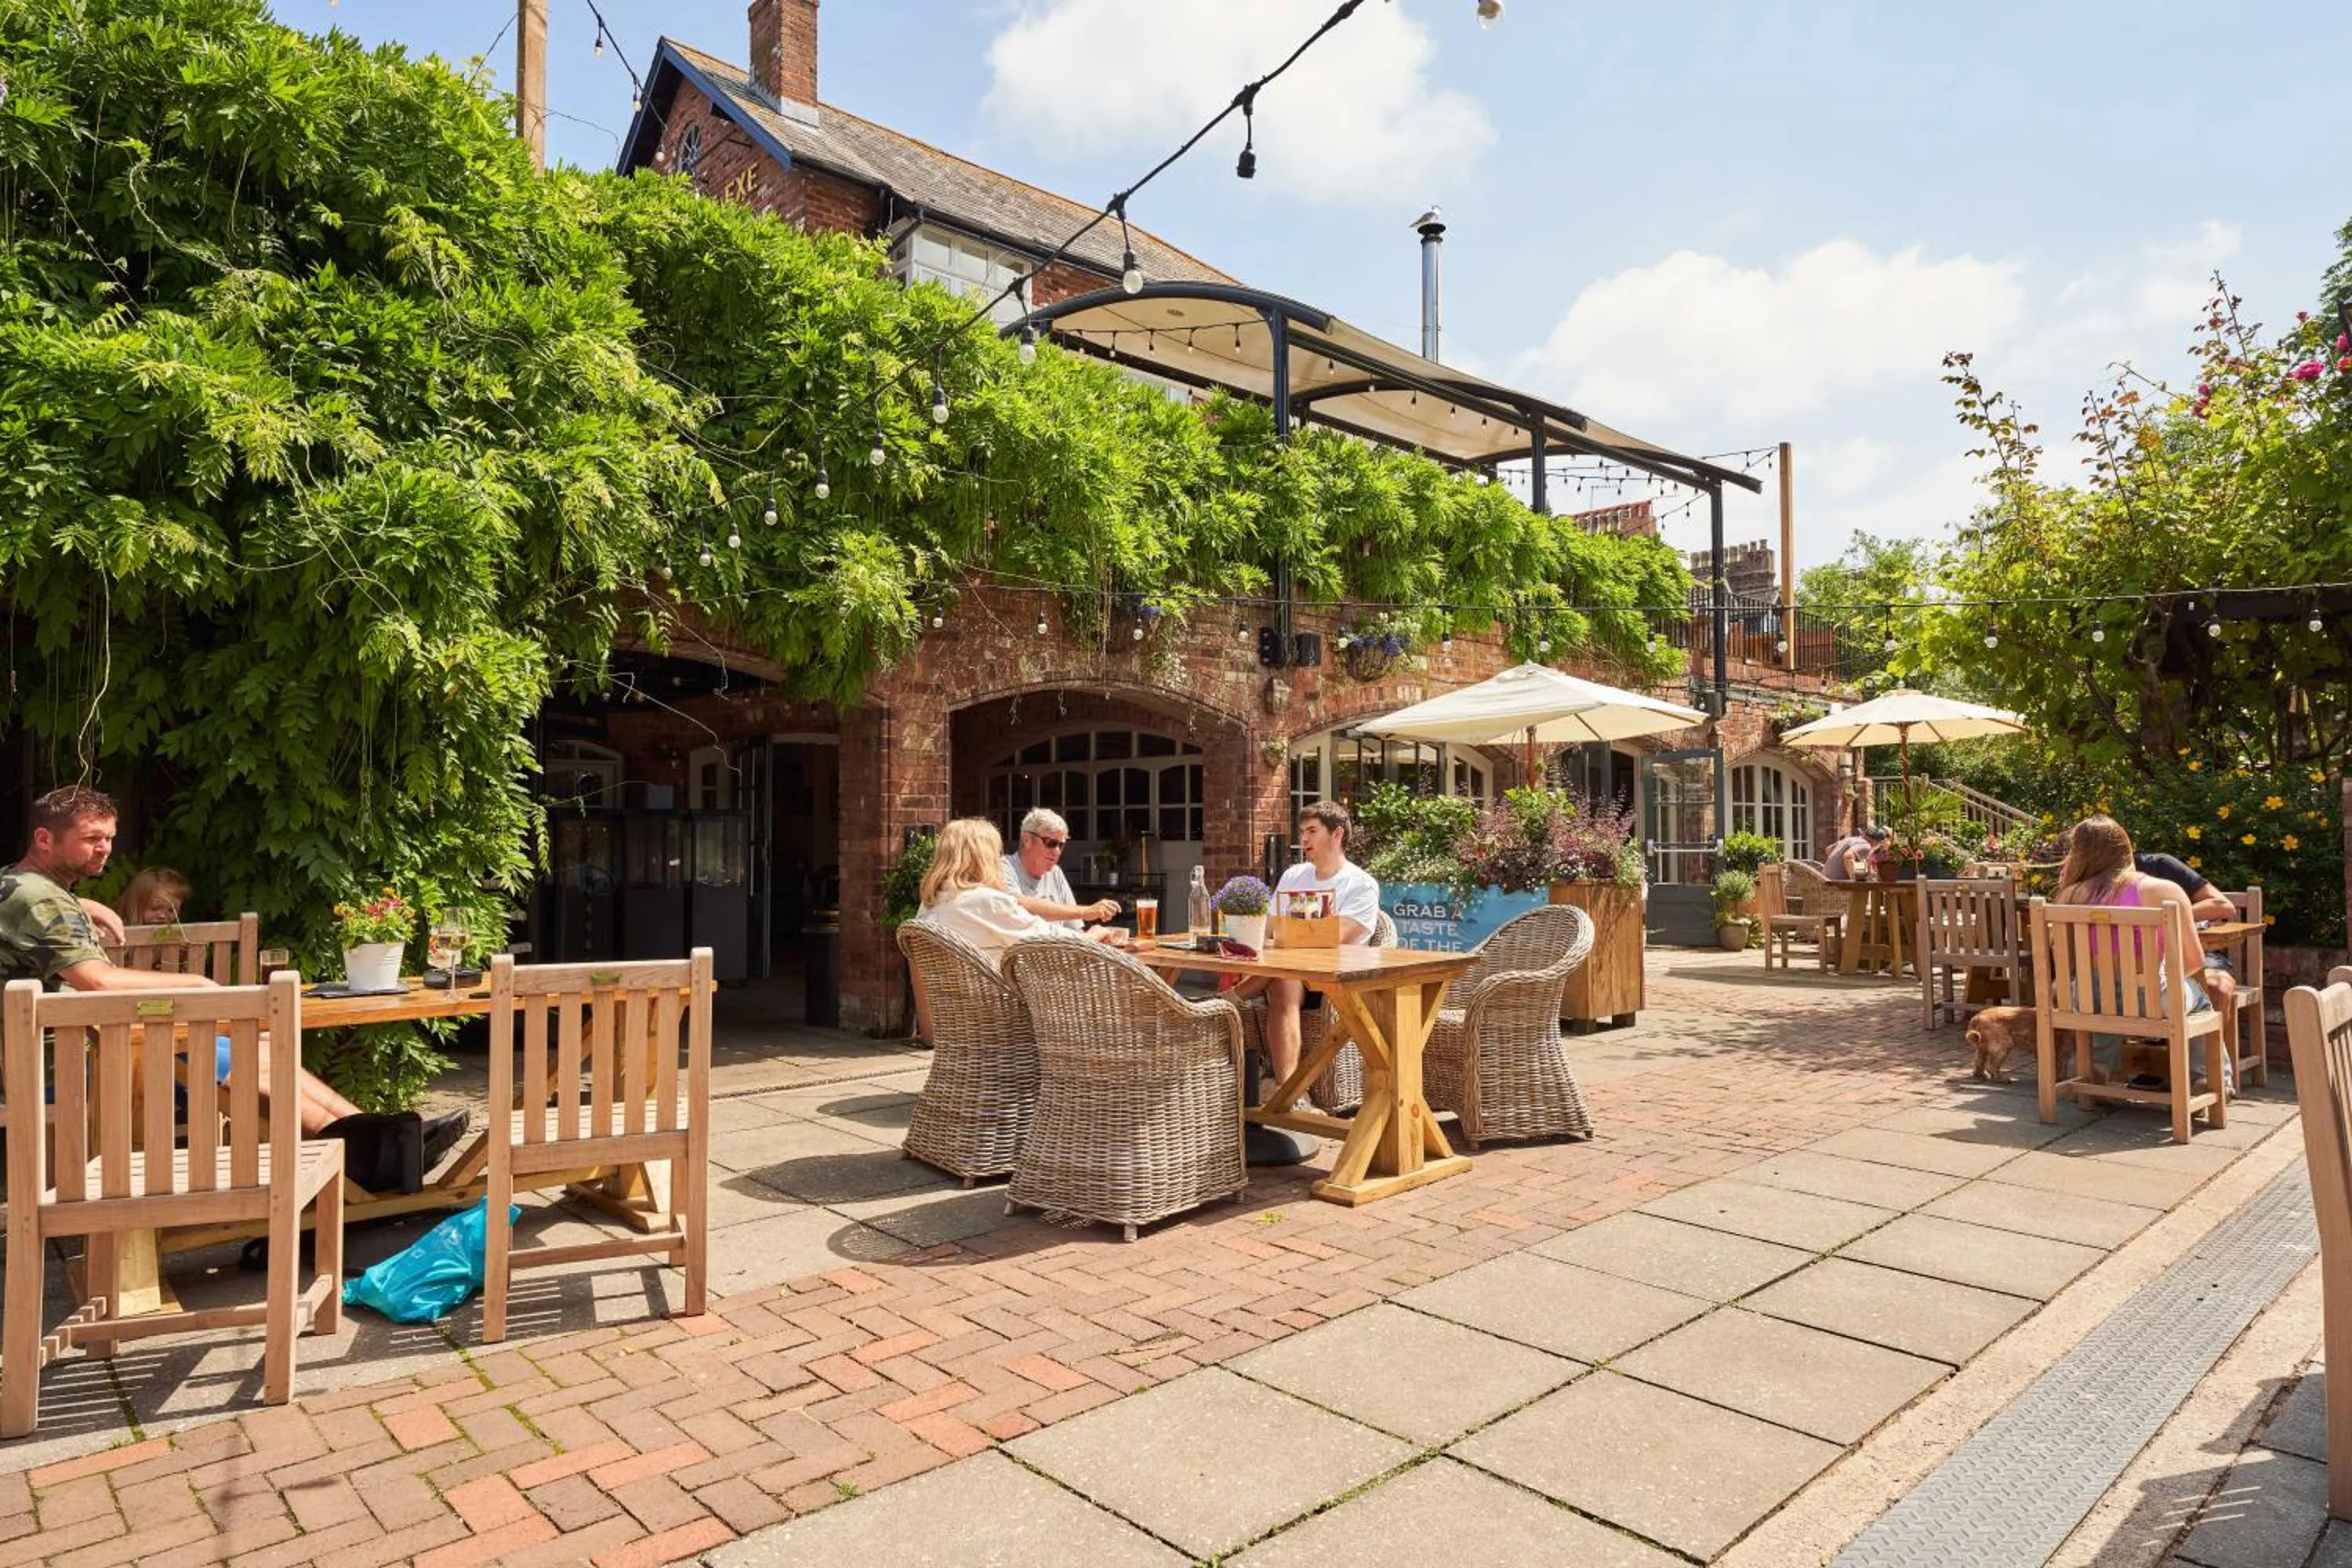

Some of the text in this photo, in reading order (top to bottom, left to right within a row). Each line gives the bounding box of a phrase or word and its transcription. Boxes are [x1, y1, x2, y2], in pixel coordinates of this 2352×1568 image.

[1393, 902, 1464, 920] GRAB A
[1403, 920, 1457, 936] TASTE
[1396, 937, 1463, 953] OF THE
